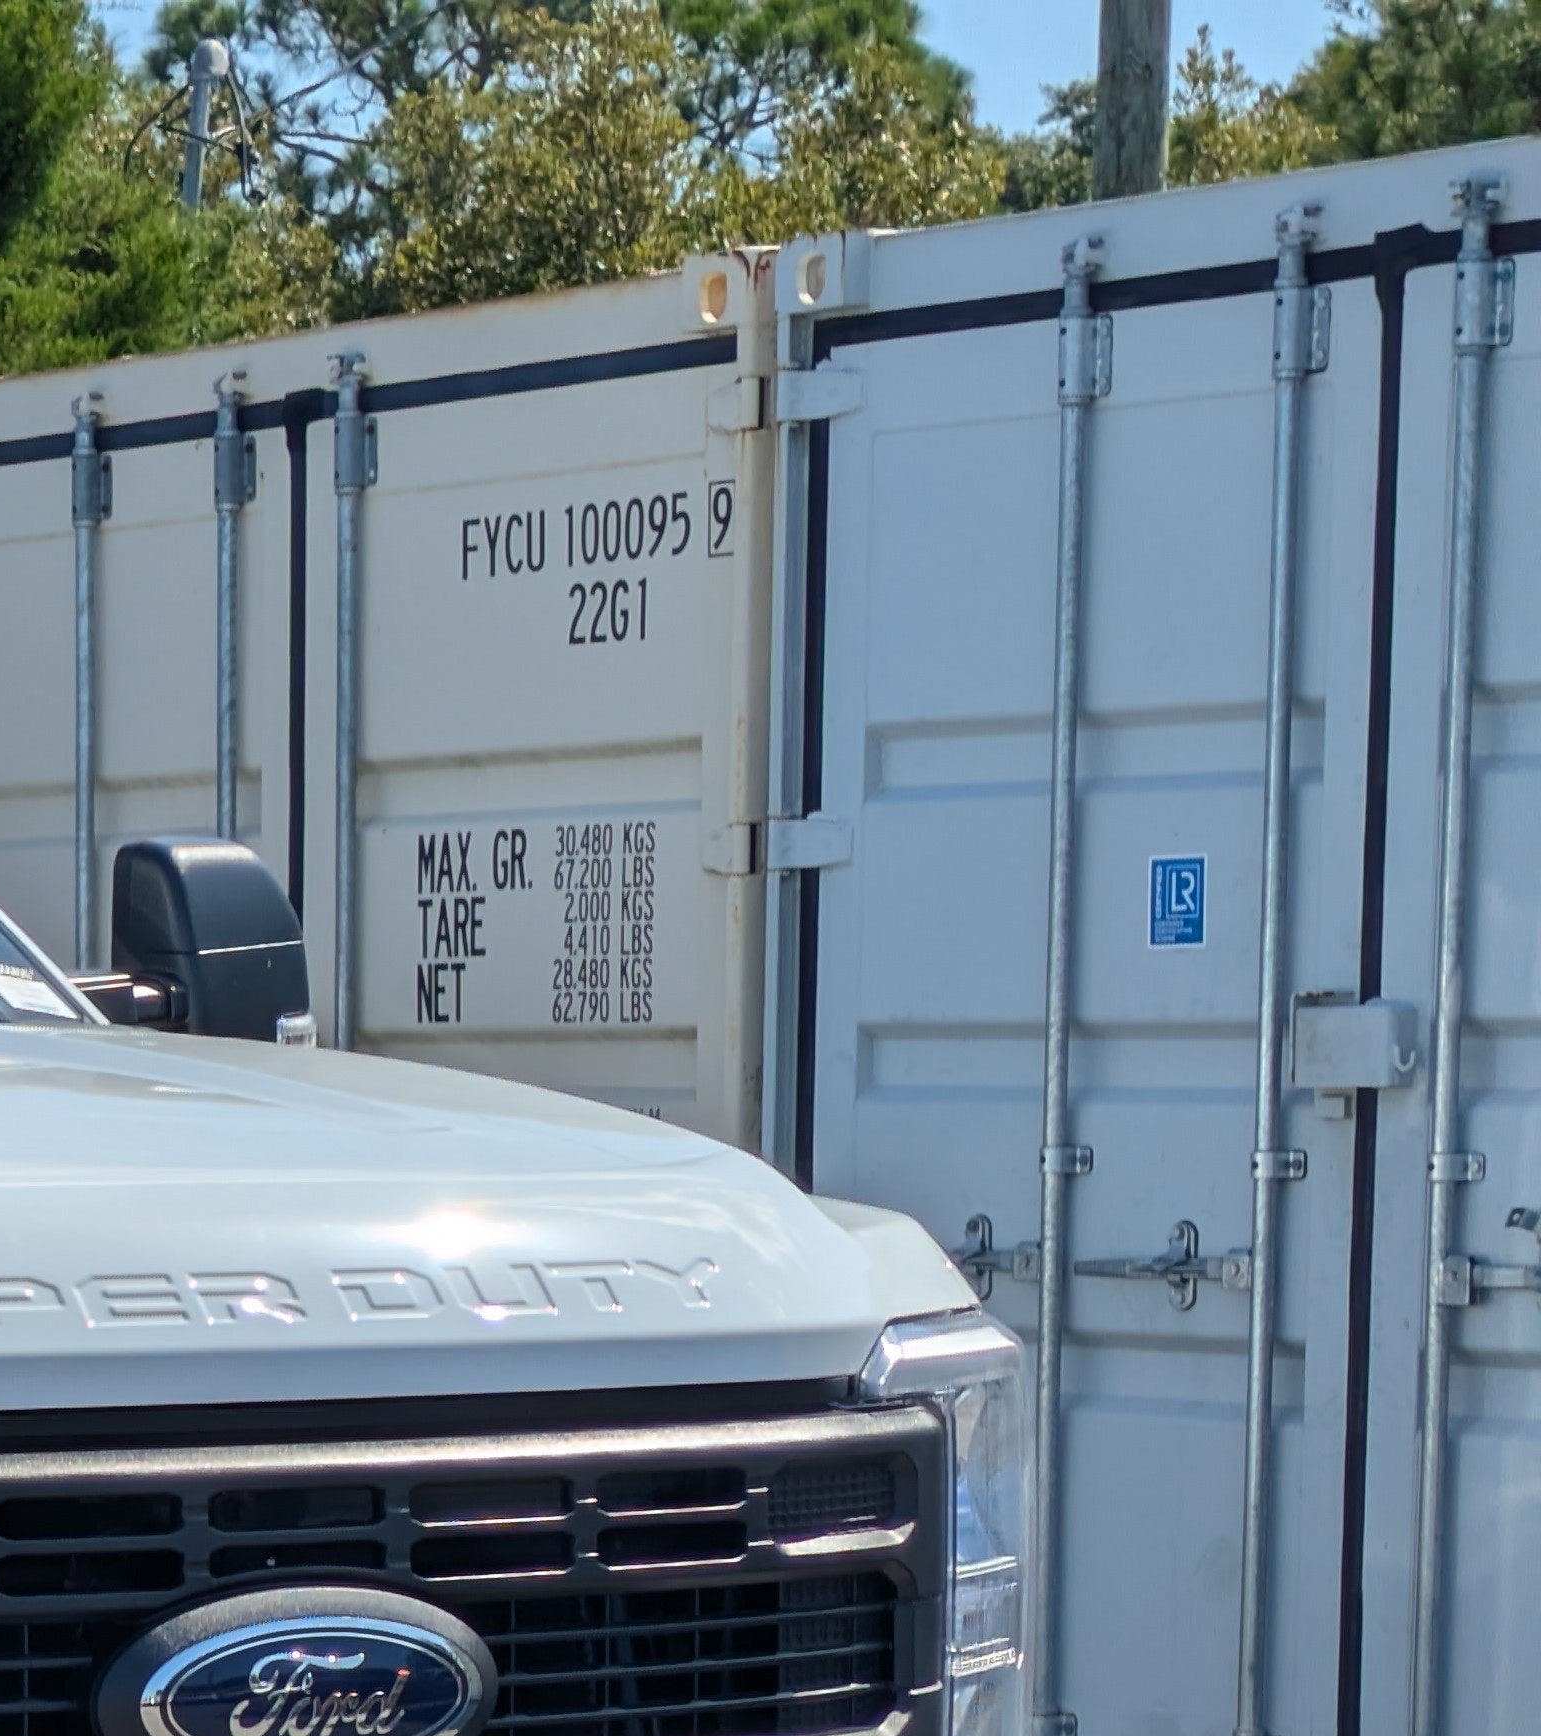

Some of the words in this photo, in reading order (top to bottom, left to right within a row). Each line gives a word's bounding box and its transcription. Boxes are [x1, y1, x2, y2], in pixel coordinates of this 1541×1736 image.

[461, 509, 546, 580] FYCU
[564, 491, 691, 568] 100095
[712, 487, 733, 550] 9
[568, 577, 647, 645] 22G1
[417, 831, 477, 894] MAX.
[492, 828, 533, 890] GR.
[555, 823, 613, 857] 30.480
[623, 821, 656, 854] KGS
[554, 857, 612, 891] 67.200
[621, 855, 655, 888] LBS
[417, 896, 486, 959] TARE
[564, 891, 612, 923] 2.000
[620, 890, 655, 922] KGS
[563, 924, 611, 956] 4.410
[620, 923, 654, 956] LBS
[417, 962, 466, 1023] NET
[552, 958, 610, 990] 28.480
[619, 957, 653, 989] KGS
[551, 991, 610, 1023] 62.790
[619, 990, 653, 1023] LBS
[329, 1257, 720, 1321] DUTY
